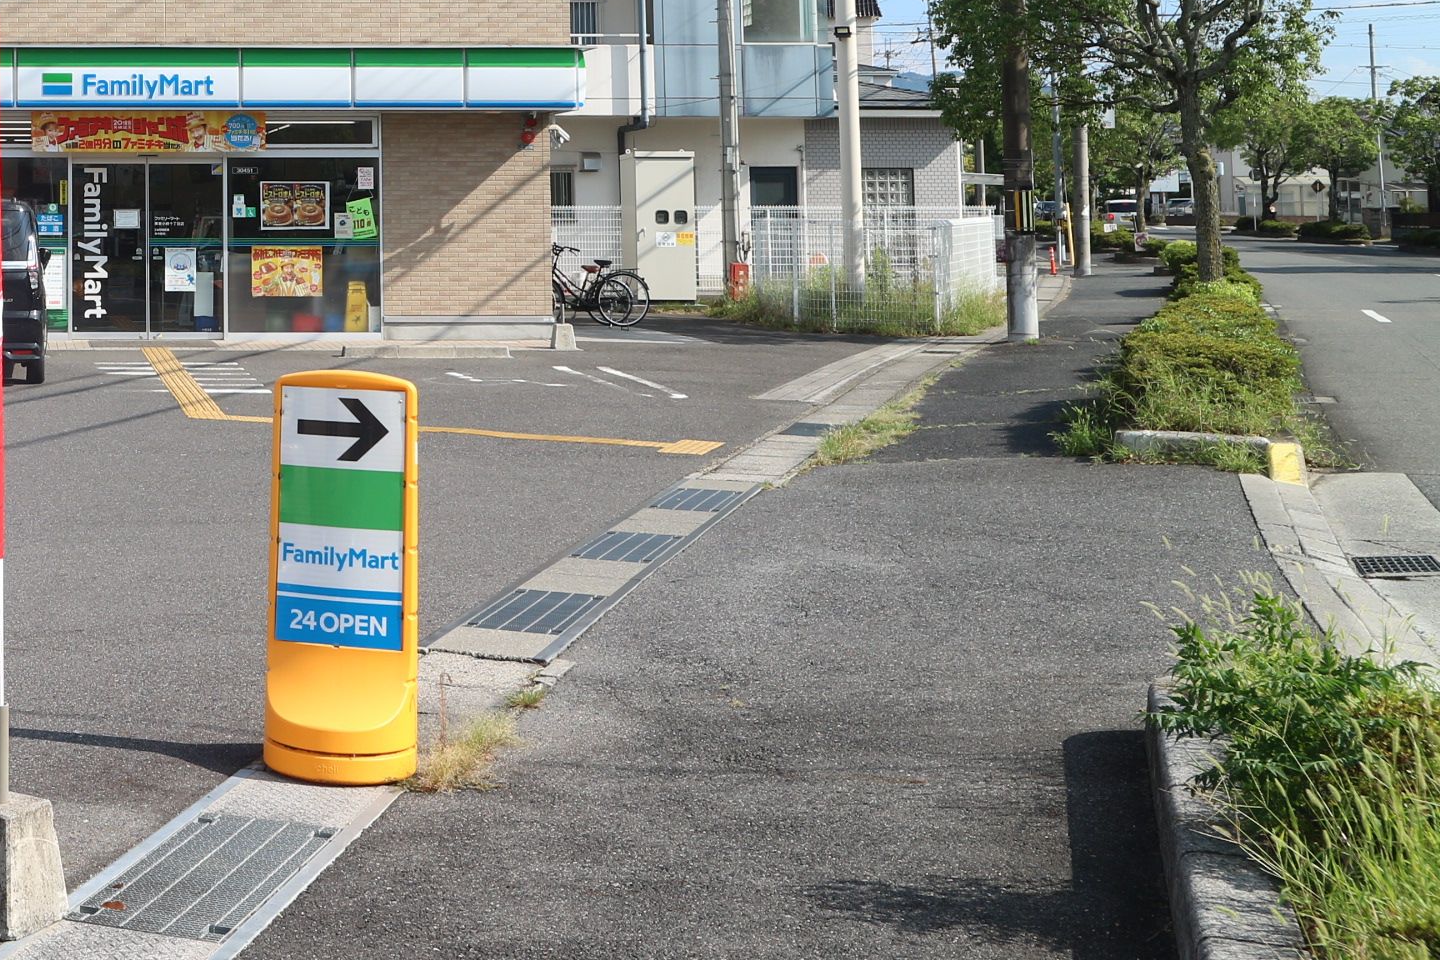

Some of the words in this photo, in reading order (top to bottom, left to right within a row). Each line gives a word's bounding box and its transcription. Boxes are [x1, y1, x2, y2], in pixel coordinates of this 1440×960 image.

[82, 73, 215, 100] FamilyMart
[77, 167, 109, 319] FamilyMart
[282, 542, 400, 572] FamilyMart
[289, 608, 317, 631] 24
[319, 611, 388, 637] OPEN
